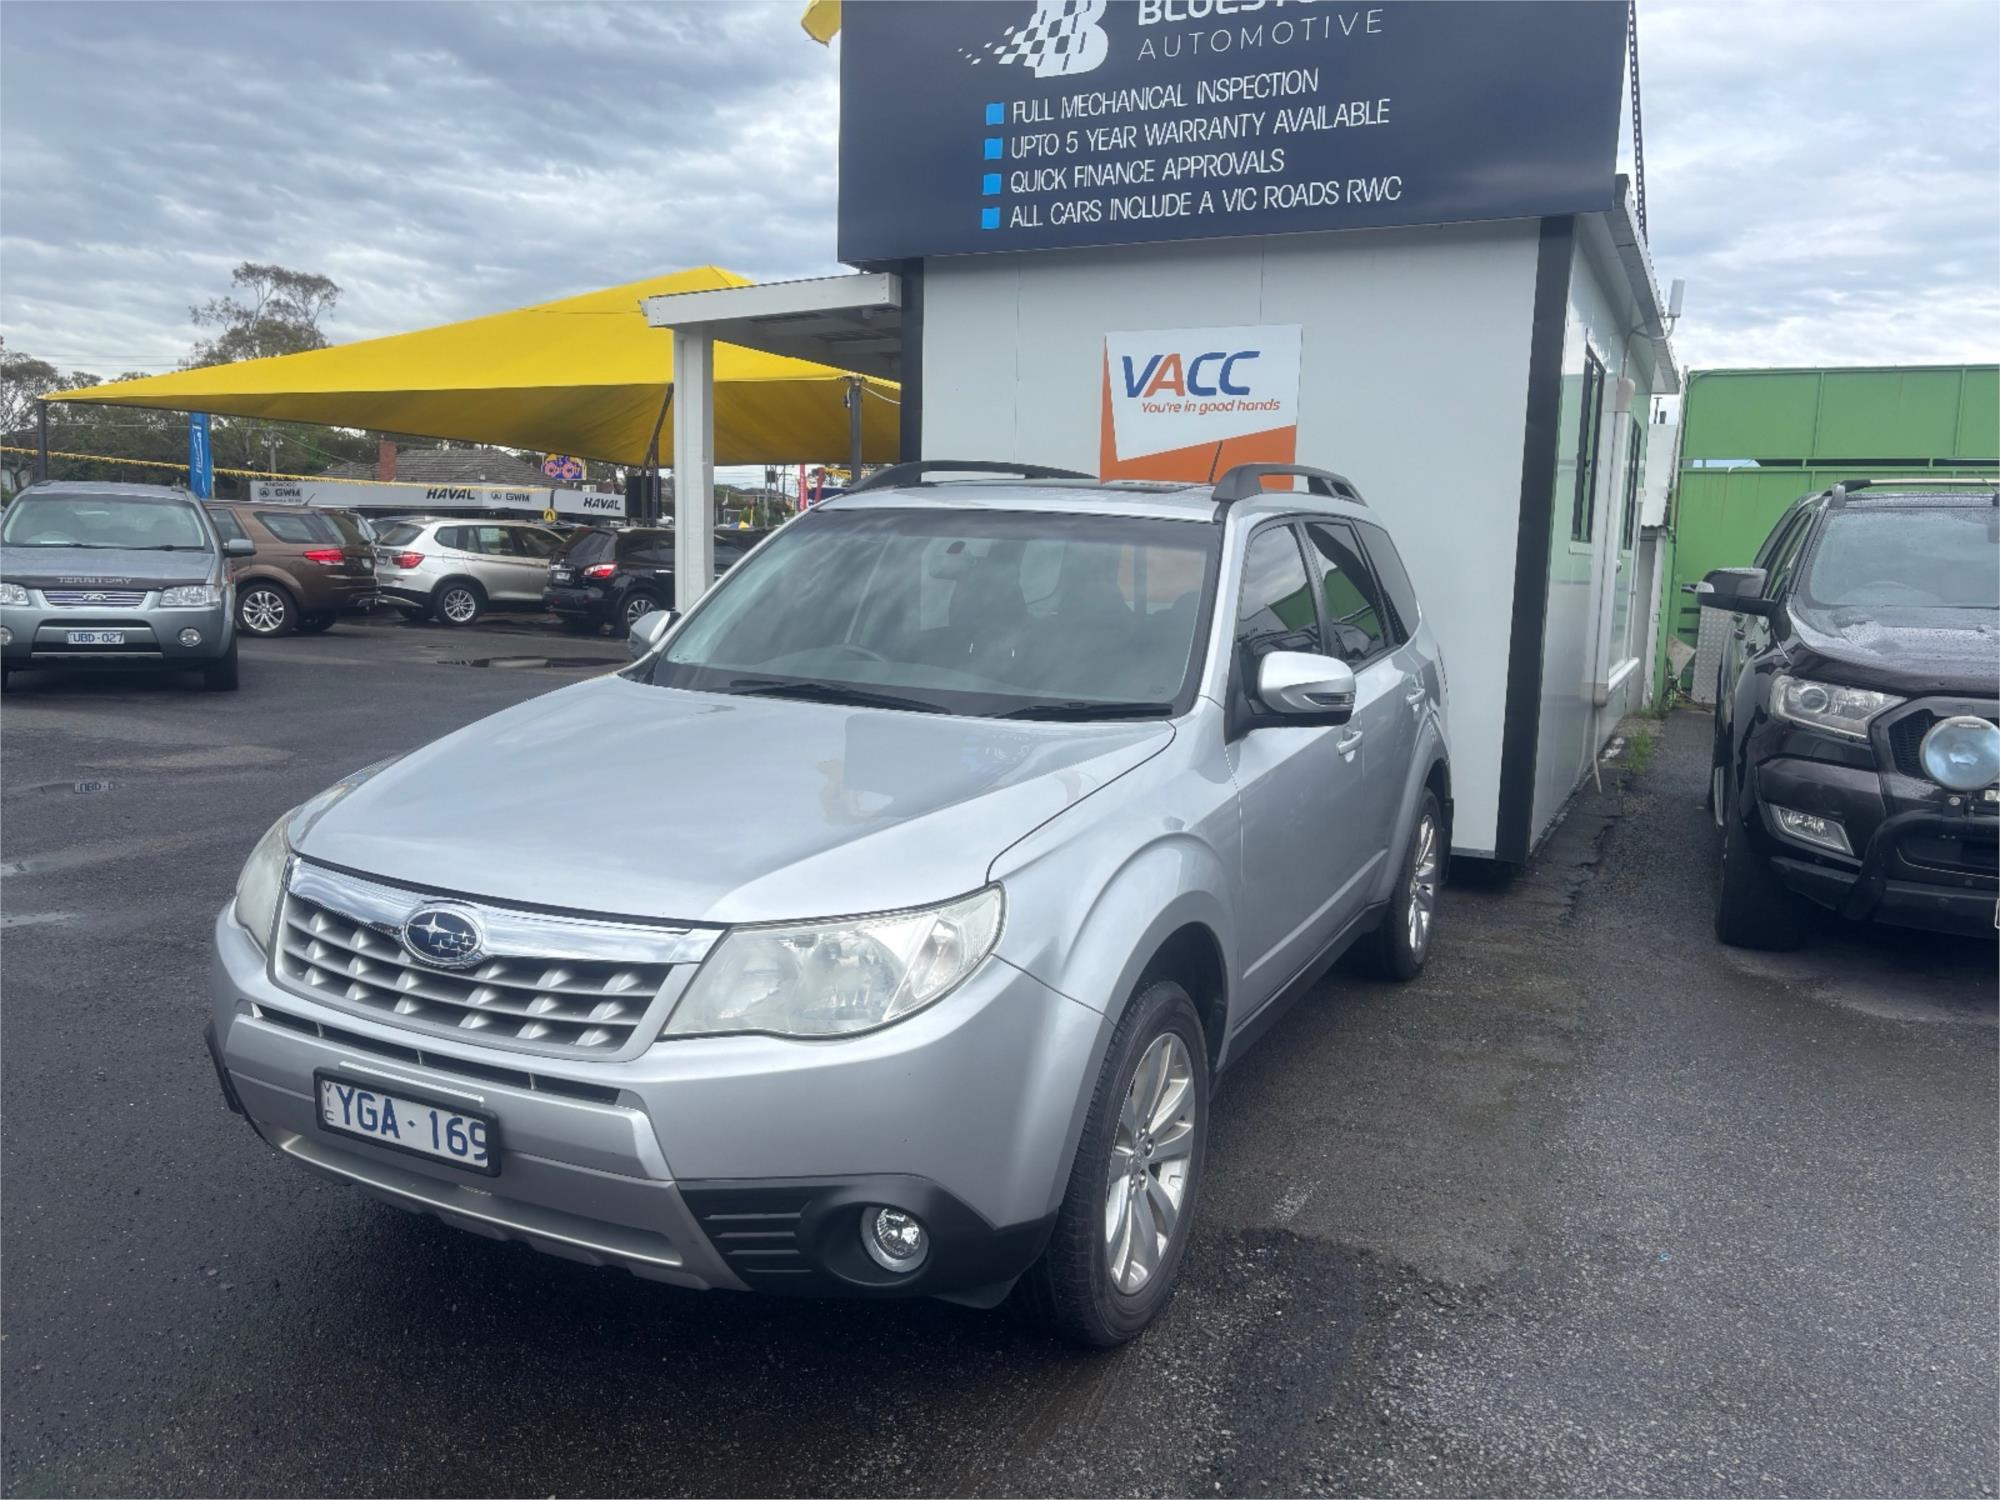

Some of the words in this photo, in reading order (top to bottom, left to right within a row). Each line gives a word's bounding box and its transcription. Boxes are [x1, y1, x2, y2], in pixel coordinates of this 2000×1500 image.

[1137, 8, 1384, 61] AUTOMOTIVE
[1012, 98, 1054, 124] FULL
[1061, 83, 1188, 119] MECHANICAL
[1196, 67, 1319, 104] INSPECTION
[1011, 133, 1060, 159] UPTO
[1065, 131, 1079, 153] 5
[1086, 126, 1137, 151] YEAR
[1144, 111, 1266, 146] WARRANTY
[1273, 98, 1391, 134] AVAILABLE
[1010, 167, 1067, 193] QUICK
[1074, 159, 1156, 188] FINANCE
[1161, 148, 1285, 181] APPROVALS
[1009, 204, 1043, 228] ALL
[1050, 200, 1102, 225] CARS
[1110, 192, 1192, 221] INCLUDE
[1198, 191, 1214, 215] A
[1222, 187, 1257, 212] VIC
[1264, 180, 1340, 209] ROADS
[1347, 175, 1402, 203] RWC
[1122, 351, 1261, 398] VACC
[1141, 402, 1181, 414] You're
[1184, 400, 1196, 413] in
[1198, 400, 1235, 416] good
[1236, 398, 1281, 412] hands
[275, 488, 301, 497] GWM
[426, 488, 476, 500] HAVAL
[505, 493, 530, 503] GWM
[583, 497, 621, 510] HAVAL
[56, 576, 132, 585] TERRITORY
